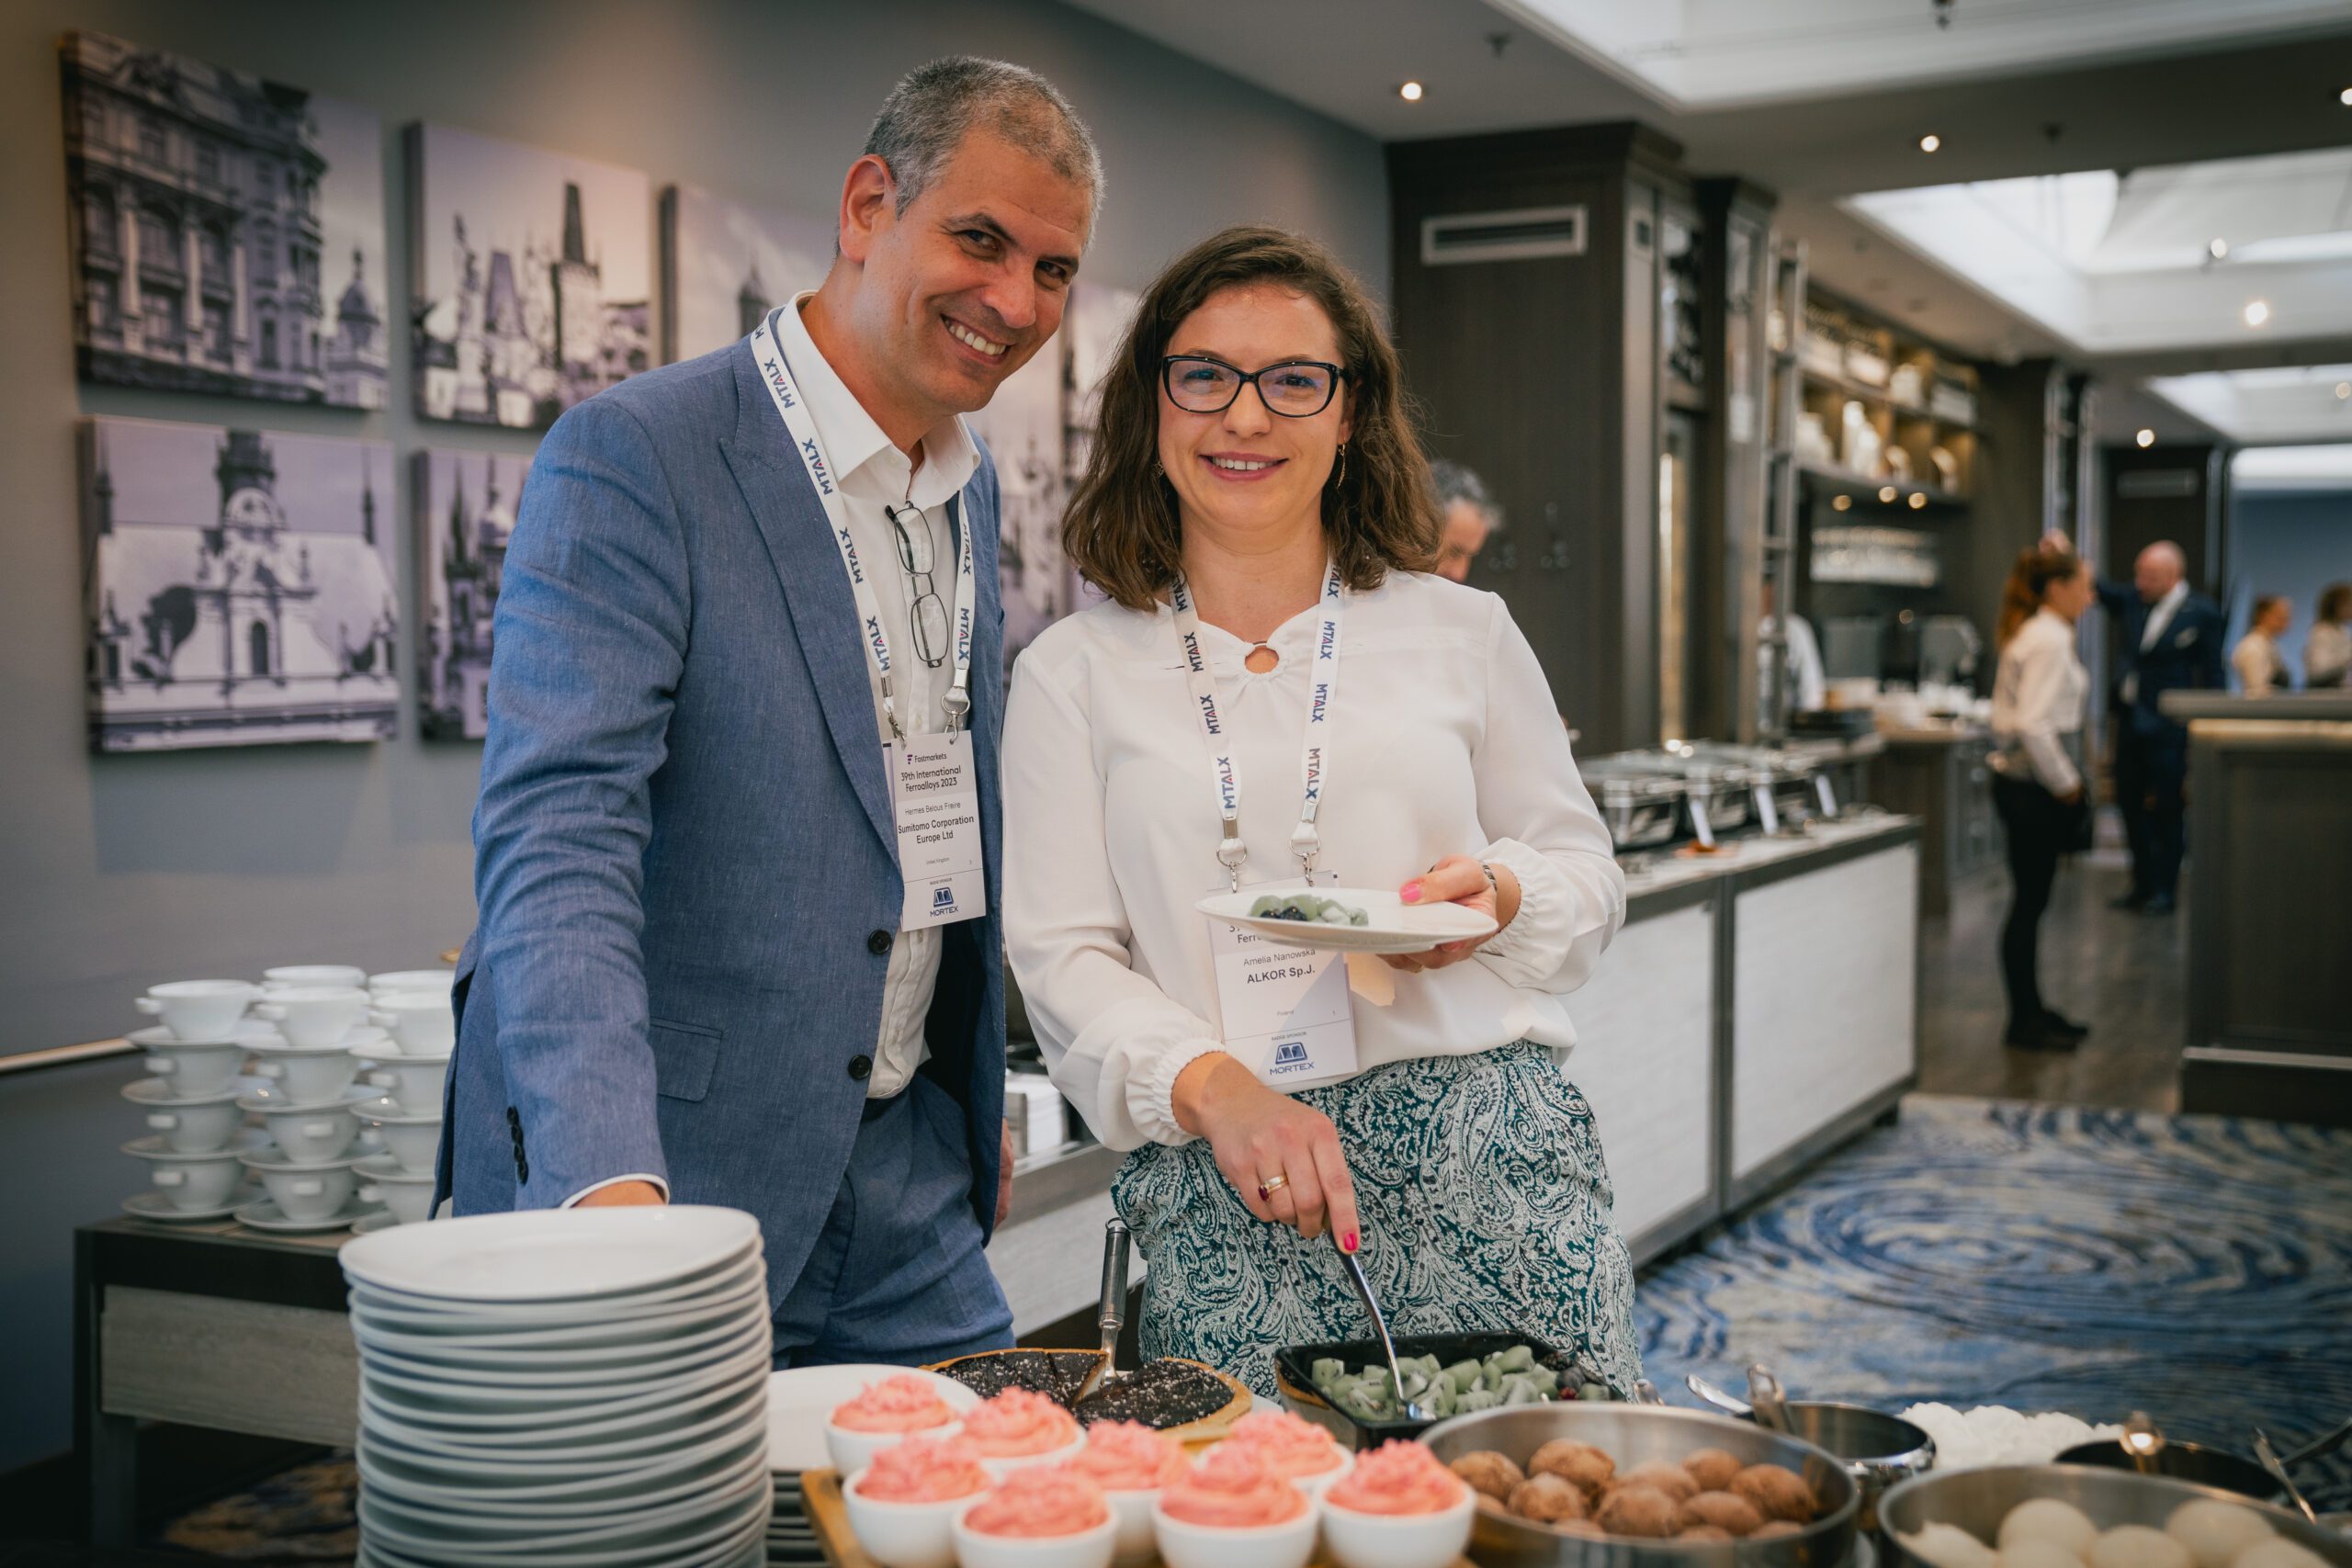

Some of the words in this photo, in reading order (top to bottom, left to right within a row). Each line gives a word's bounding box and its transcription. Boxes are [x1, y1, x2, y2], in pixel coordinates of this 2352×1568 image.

[764, 357, 796, 409] MTALX
[801, 437, 833, 495] MTALX
[839, 526, 864, 584] MTALX
[1327, 567, 1341, 598] ALX
[866, 615, 890, 671] MTALX
[958, 607, 970, 661] MTALX
[1183, 631, 1204, 672] MTALX
[1319, 620, 1336, 660] MTALX
[1199, 694, 1221, 735] MTALX
[1311, 683, 1329, 723] MTALX
[900, 772, 916, 782] 39th
[915, 765, 962, 780] International
[914, 752, 947, 763] Fastmarkets
[1306, 748, 1320, 800] MTALX
[905, 781, 940, 792] Ferroalloys
[940, 777, 957, 788] 2023
[1216, 756, 1237, 809] MTALX
[898, 822, 930, 834] Sumitomo
[931, 815, 975, 829] Corporation
[905, 807, 925, 816] Hermes
[944, 801, 961, 810] Freire
[916, 833, 941, 844] Europe
[942, 829, 954, 840] Ltd
[930, 905, 959, 918] MORTEX
[1243, 955, 1272, 966] Amelia
[1273, 948, 1316, 962] Nanowska
[1247, 968, 1286, 984] ALKOR
[1289, 964, 1316, 978] Sp.J.
[1269, 1061, 1315, 1076] MORTEX
